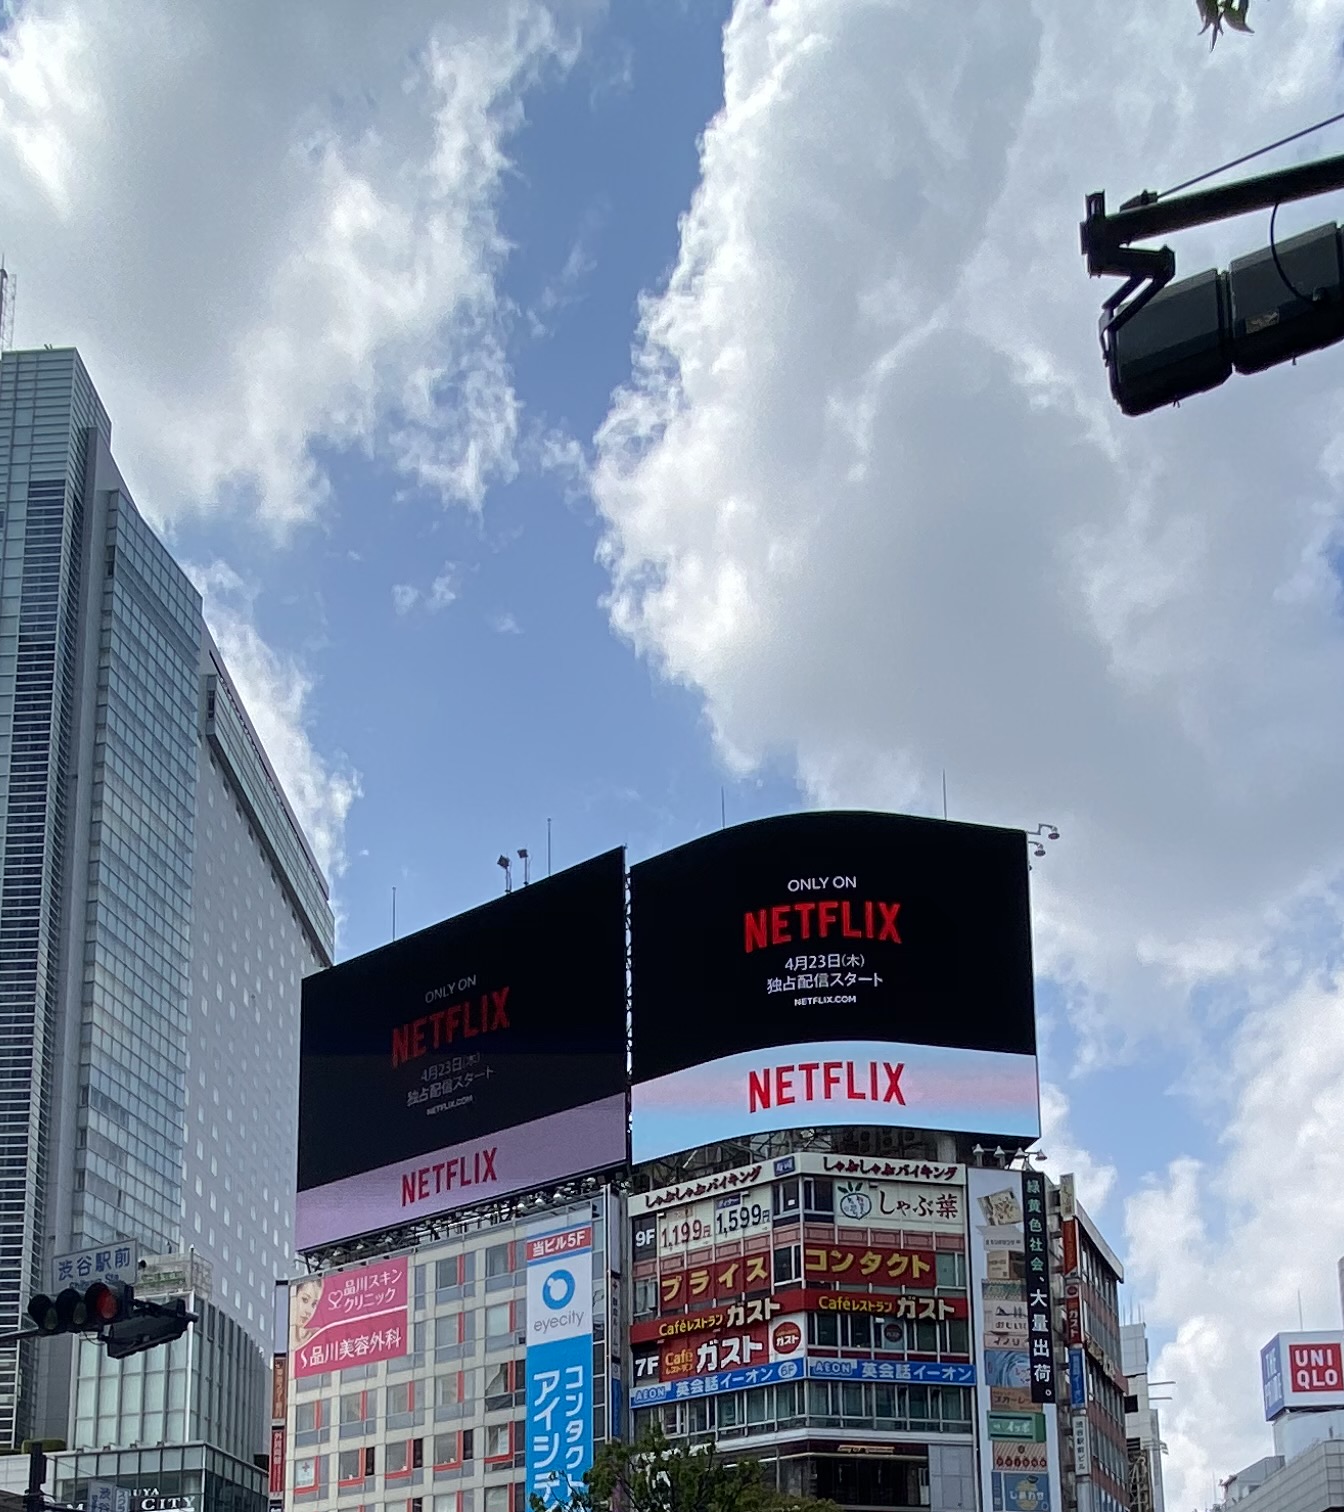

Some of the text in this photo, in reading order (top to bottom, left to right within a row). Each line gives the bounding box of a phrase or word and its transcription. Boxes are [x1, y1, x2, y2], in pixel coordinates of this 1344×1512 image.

[787, 876, 857, 892] ONLY ON
[744, 901, 902, 953] NETFLIX
[785, 953, 865, 971] 4月23日(木)
[425, 974, 477, 1003] ONLY ON
[767, 972, 883, 995] 独占配信スタート
[794, 995, 857, 1006] NETFLIX.COM
[392, 986, 510, 1069] NETFLIX
[407, 1065, 494, 1107] 独占配信スタート
[749, 1061, 906, 1113] NETFLIX
[401, 1147, 497, 1207] NETFLIX
[823, 1156, 958, 1181] しゃぶしゃぶバイキング
[646, 1165, 762, 1208] しゃぶしゃぶバイキング
[879, 1190, 958, 1219] しゃぶ葉
[532, 1231, 586, 1258] 当ビル5F
[635, 1229, 655, 1247] 9F
[58, 1247, 130, 1281] 渋谷駅前
[806, 1250, 930, 1278] コンタクト
[343, 1269, 403, 1294] 品川スキン
[662, 1257, 768, 1301] プライス
[344, 1287, 396, 1313] クリニック
[897, 1296, 955, 1321] ガスト
[533, 1309, 585, 1334] eyecity
[727, 1298, 781, 1328] ガスト
[309, 1327, 401, 1366] 品川美容外科
[776, 1335, 799, 1347] ガスト
[635, 1356, 659, 1377] 7F
[696, 1335, 763, 1374] ガスト
[1295, 1349, 1333, 1367] UNI
[815, 1362, 851, 1374] AEON
[861, 1362, 972, 1380] 英会話イーオン
[1296, 1368, 1338, 1390] QLO
[635, 1387, 666, 1401] AEON
[676, 1368, 774, 1398] 英会話イーオン
[141, 1496, 196, 1510] CITY
